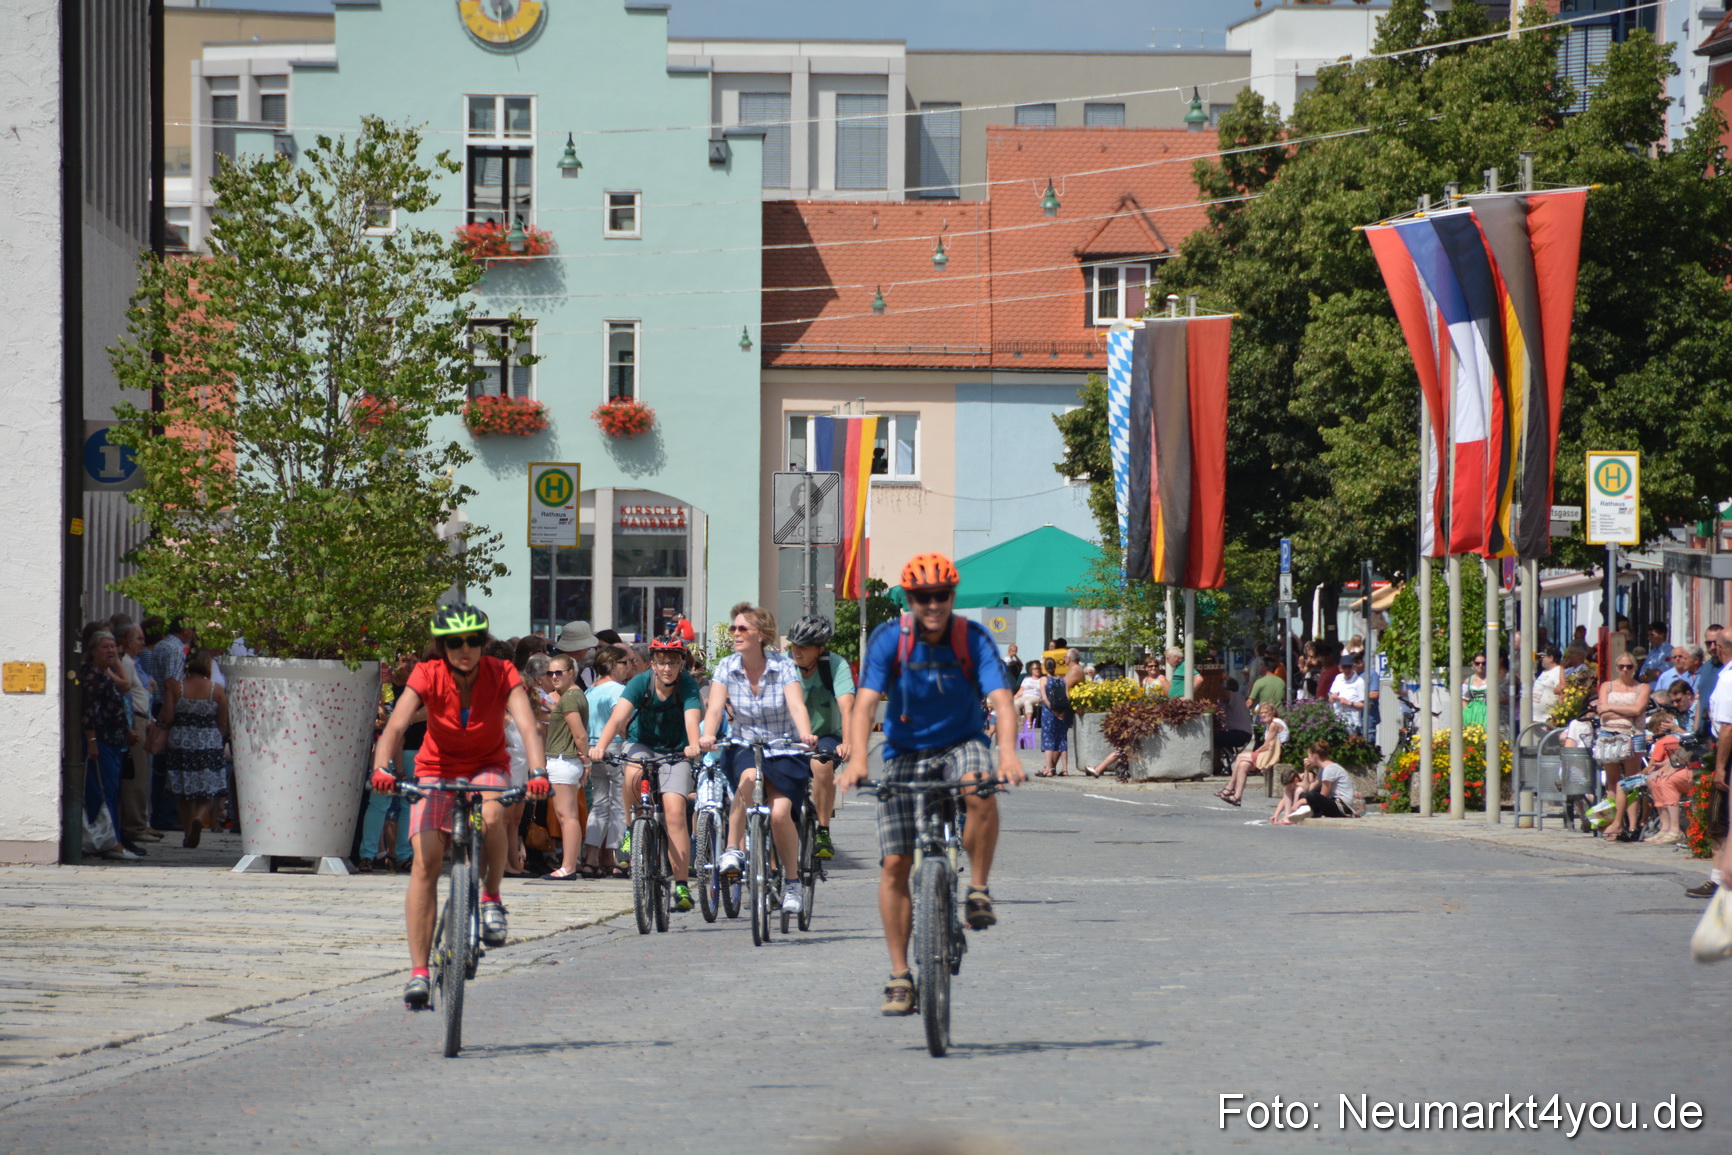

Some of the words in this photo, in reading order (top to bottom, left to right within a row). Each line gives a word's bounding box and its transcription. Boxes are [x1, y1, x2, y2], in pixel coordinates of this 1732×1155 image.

[1605, 466, 1621, 489] H
[545, 477, 564, 499] H
[620, 505, 672, 515] KIRSCH
[676, 505, 685, 515] &
[620, 518, 686, 528] HAUBNER
[790, 525, 824, 538] ZOE
[1381, 656, 1389, 669] P
